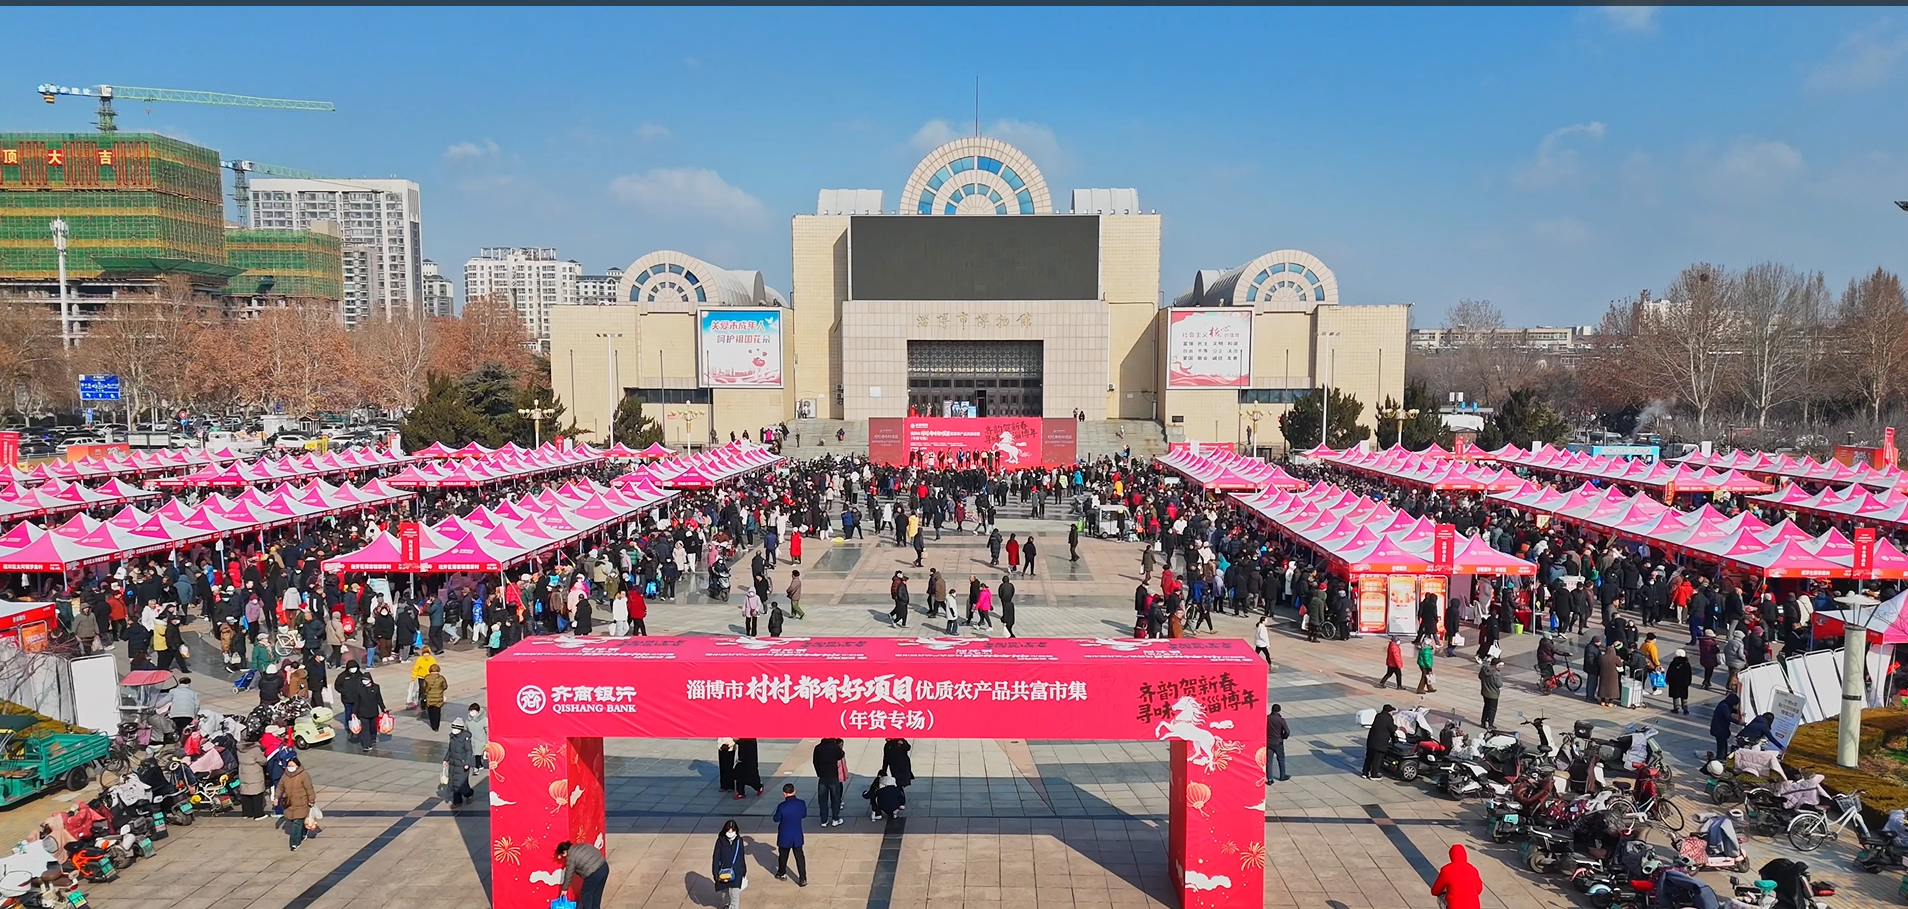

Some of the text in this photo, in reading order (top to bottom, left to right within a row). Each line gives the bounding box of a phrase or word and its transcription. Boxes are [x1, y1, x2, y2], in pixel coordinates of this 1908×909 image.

[711, 320, 766, 331] 关爱未成年人
[916, 311, 1033, 331] 淄博市博物馆
[716, 334, 771, 344] 呵护祖国花朵
[551, 685, 637, 702] 齐商银行
[686, 673, 1088, 709] 淄博市村村都有好项目优质农产品共富市集
[1138, 672, 1238, 703] 齐韵贺新春
[552, 704, 637, 714] QISHANG BANK
[840, 709, 935, 730] （年货专场）
